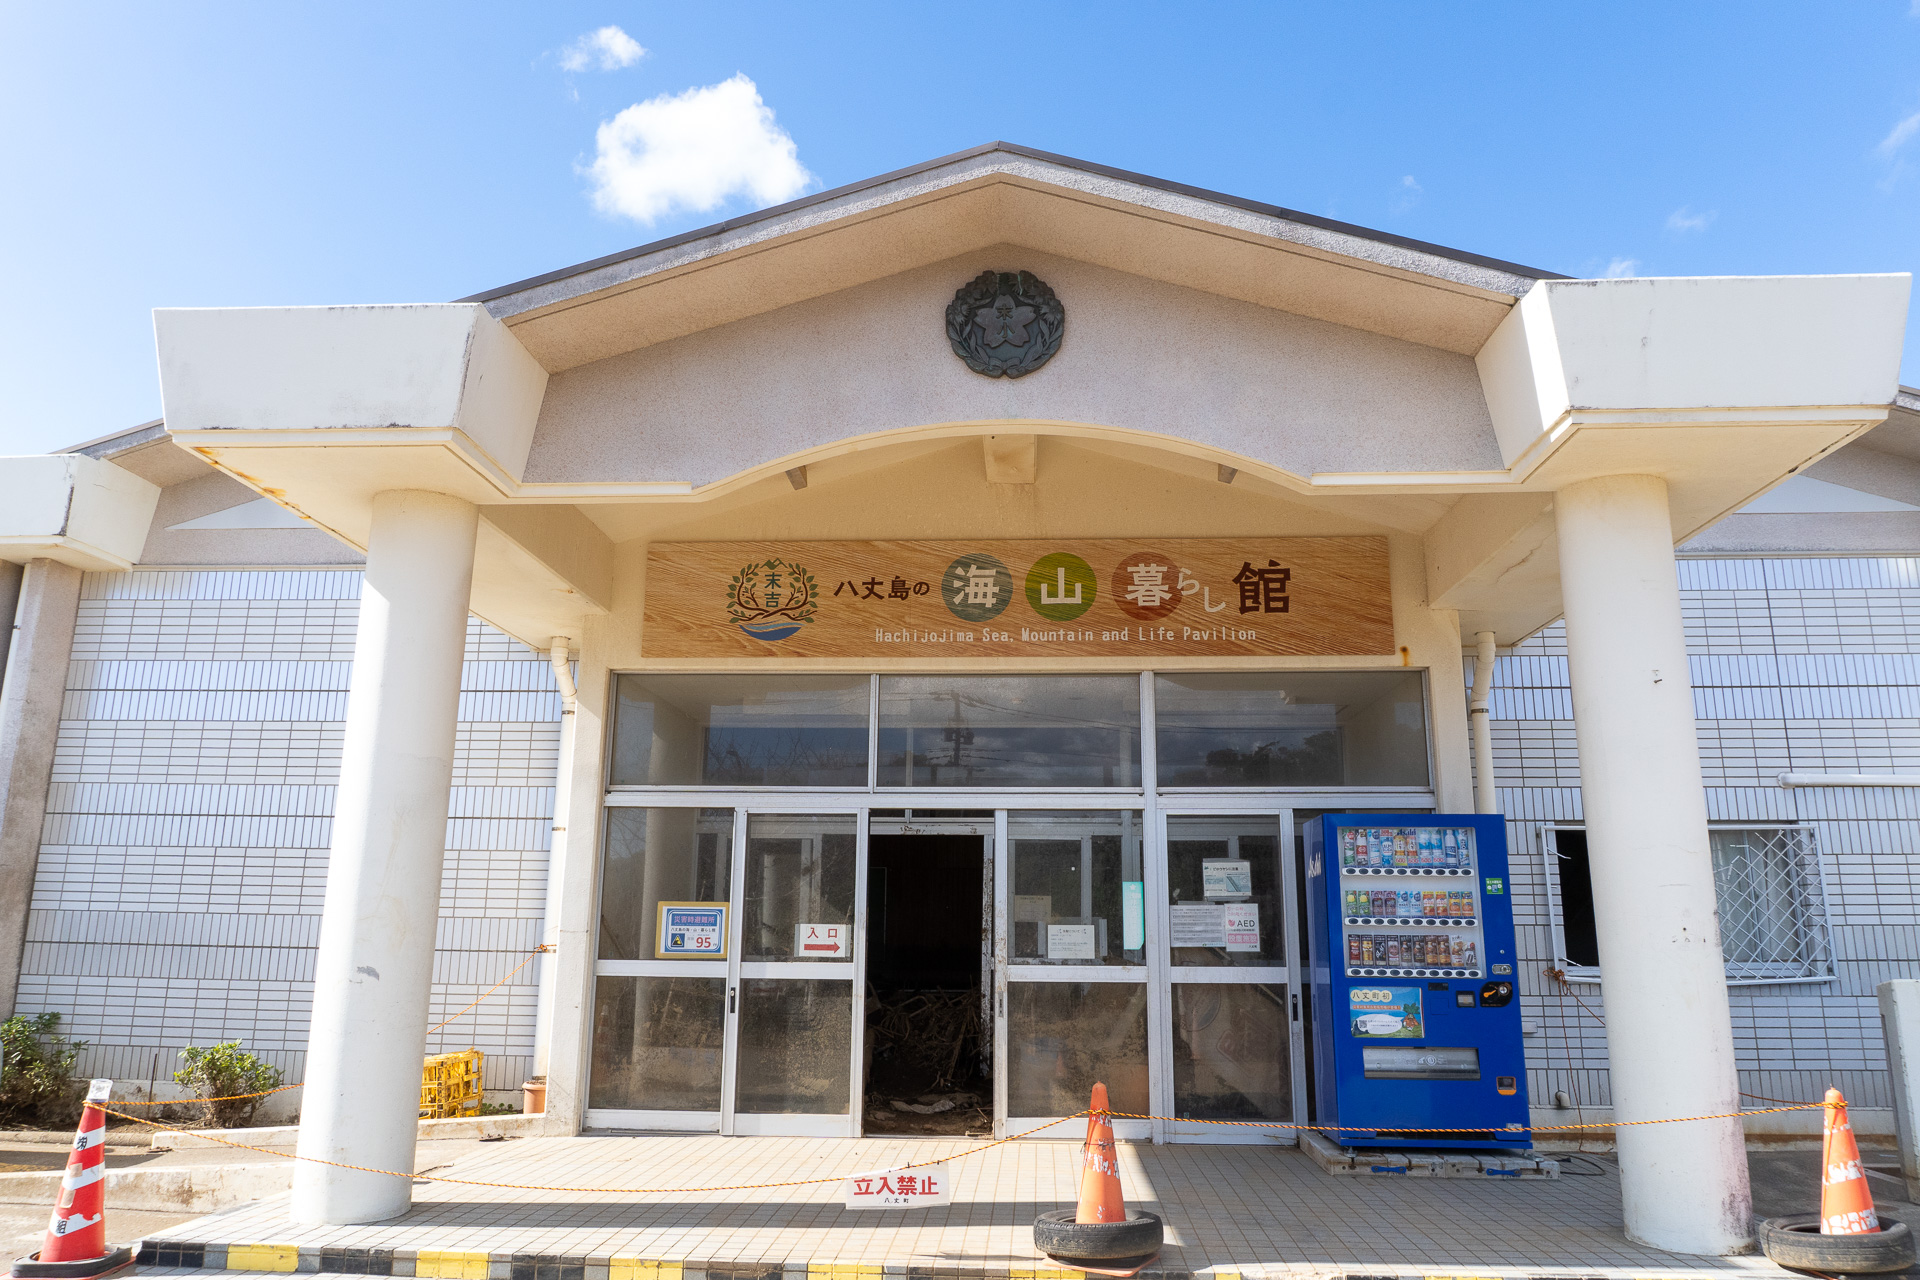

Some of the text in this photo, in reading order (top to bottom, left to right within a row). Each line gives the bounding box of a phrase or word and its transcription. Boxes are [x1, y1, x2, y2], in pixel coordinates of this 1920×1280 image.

[996, 304, 1015, 338] 末小
[764, 571, 782, 608] 末吉
[875, 627, 1256, 643] Hachijojima Sea, Mountain and Life Pavilion
[1236, 919, 1256, 928] AED
[807, 927, 838, 939] 入口
[695, 936, 711, 949] 95
[853, 1175, 940, 1196] 立入禁止
